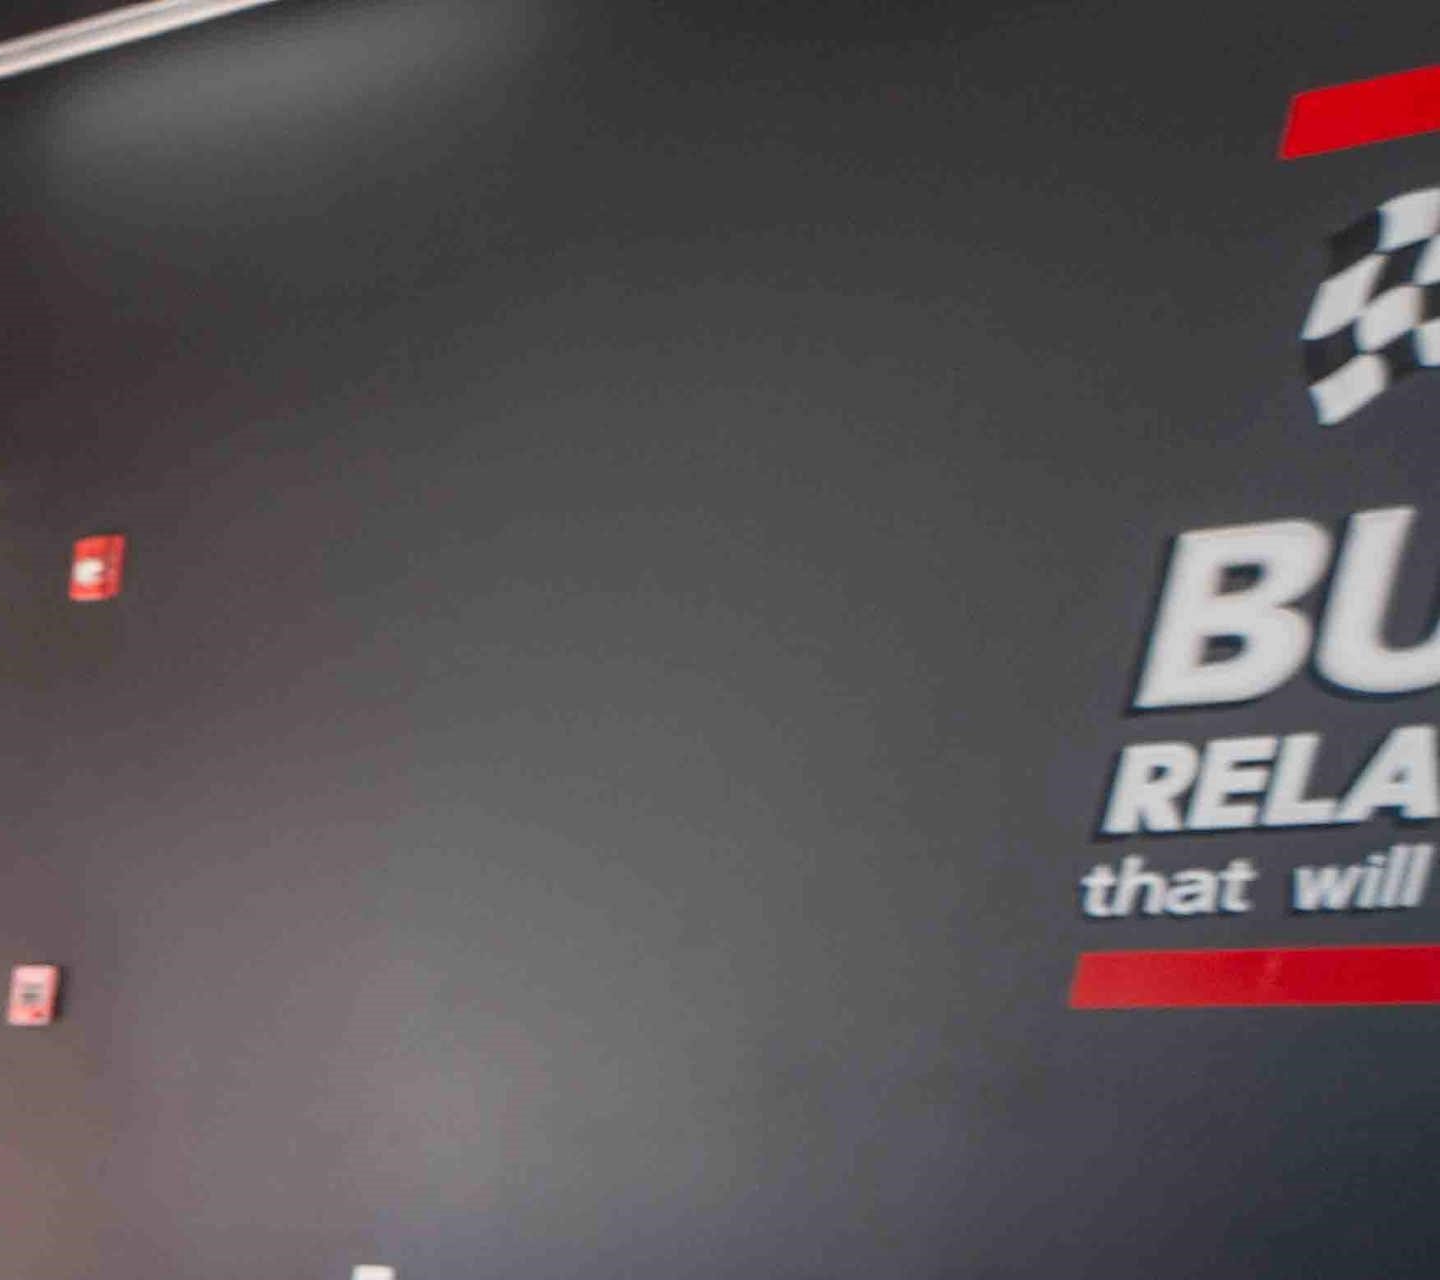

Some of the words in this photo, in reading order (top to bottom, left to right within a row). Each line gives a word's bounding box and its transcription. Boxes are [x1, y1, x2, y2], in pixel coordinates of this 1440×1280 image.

[1128, 505, 1440, 710] BU
[1098, 723, 1440, 835] RELA
[1080, 855, 1258, 917] that
[1291, 842, 1435, 911] will
